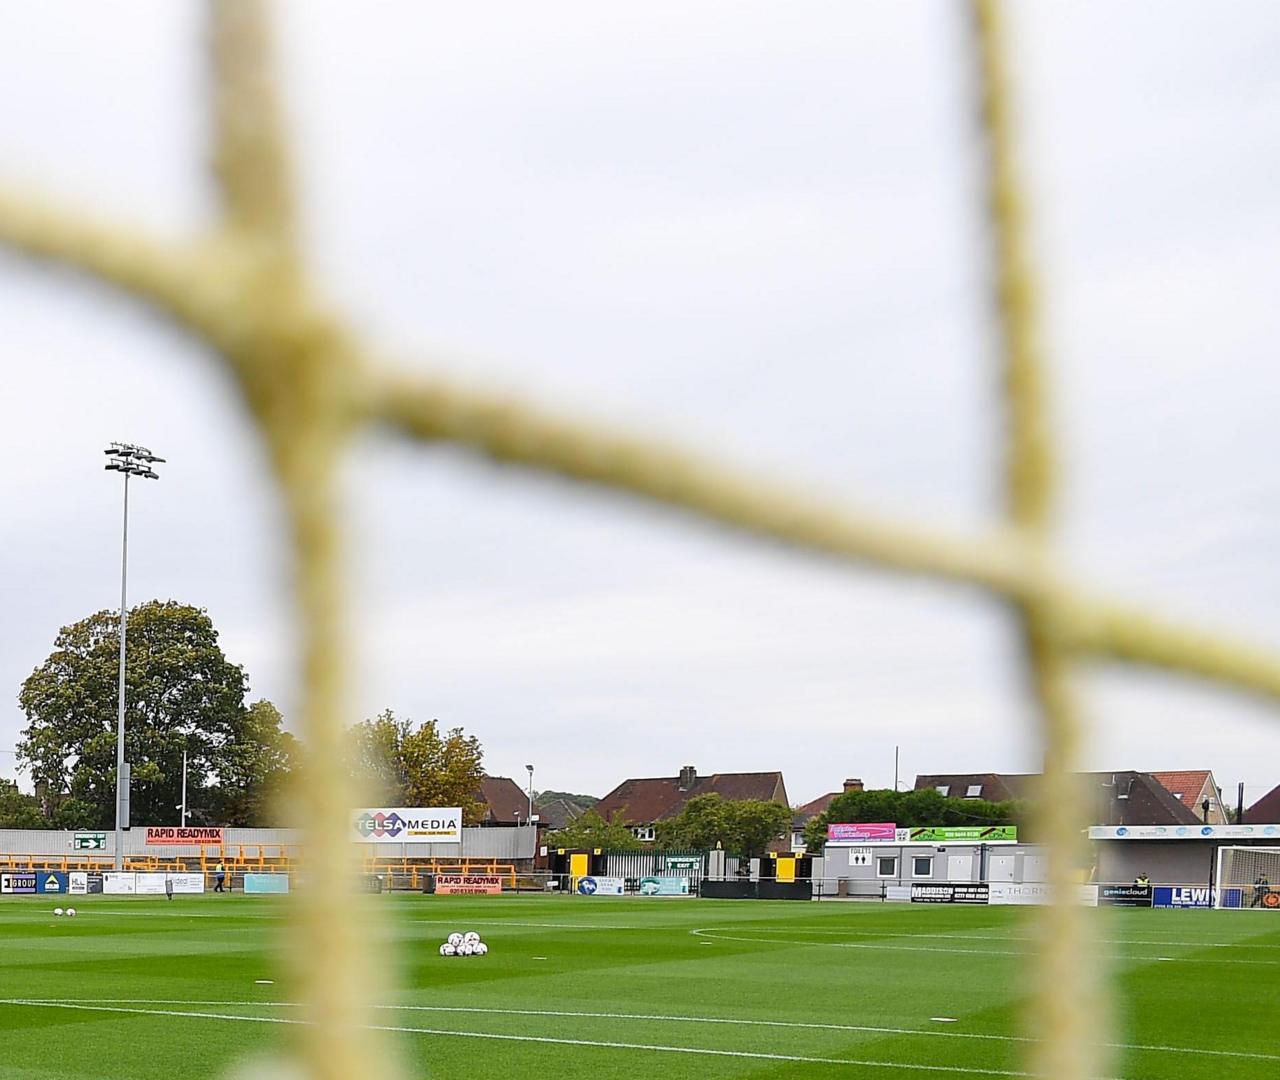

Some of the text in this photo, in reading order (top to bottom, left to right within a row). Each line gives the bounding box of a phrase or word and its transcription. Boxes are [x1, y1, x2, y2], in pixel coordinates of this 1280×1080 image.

[357, 819, 457, 830] TELSA MEDIA
[148, 828, 221, 838] RAPID READYMIX
[12, 879, 36, 888] GROUP
[438, 877, 500, 885] RAPID READYMIX
[912, 887, 954, 898] MADDISON
[1103, 888, 1148, 896] geniecloud
[1171, 888, 1220, 902] LEWIN
